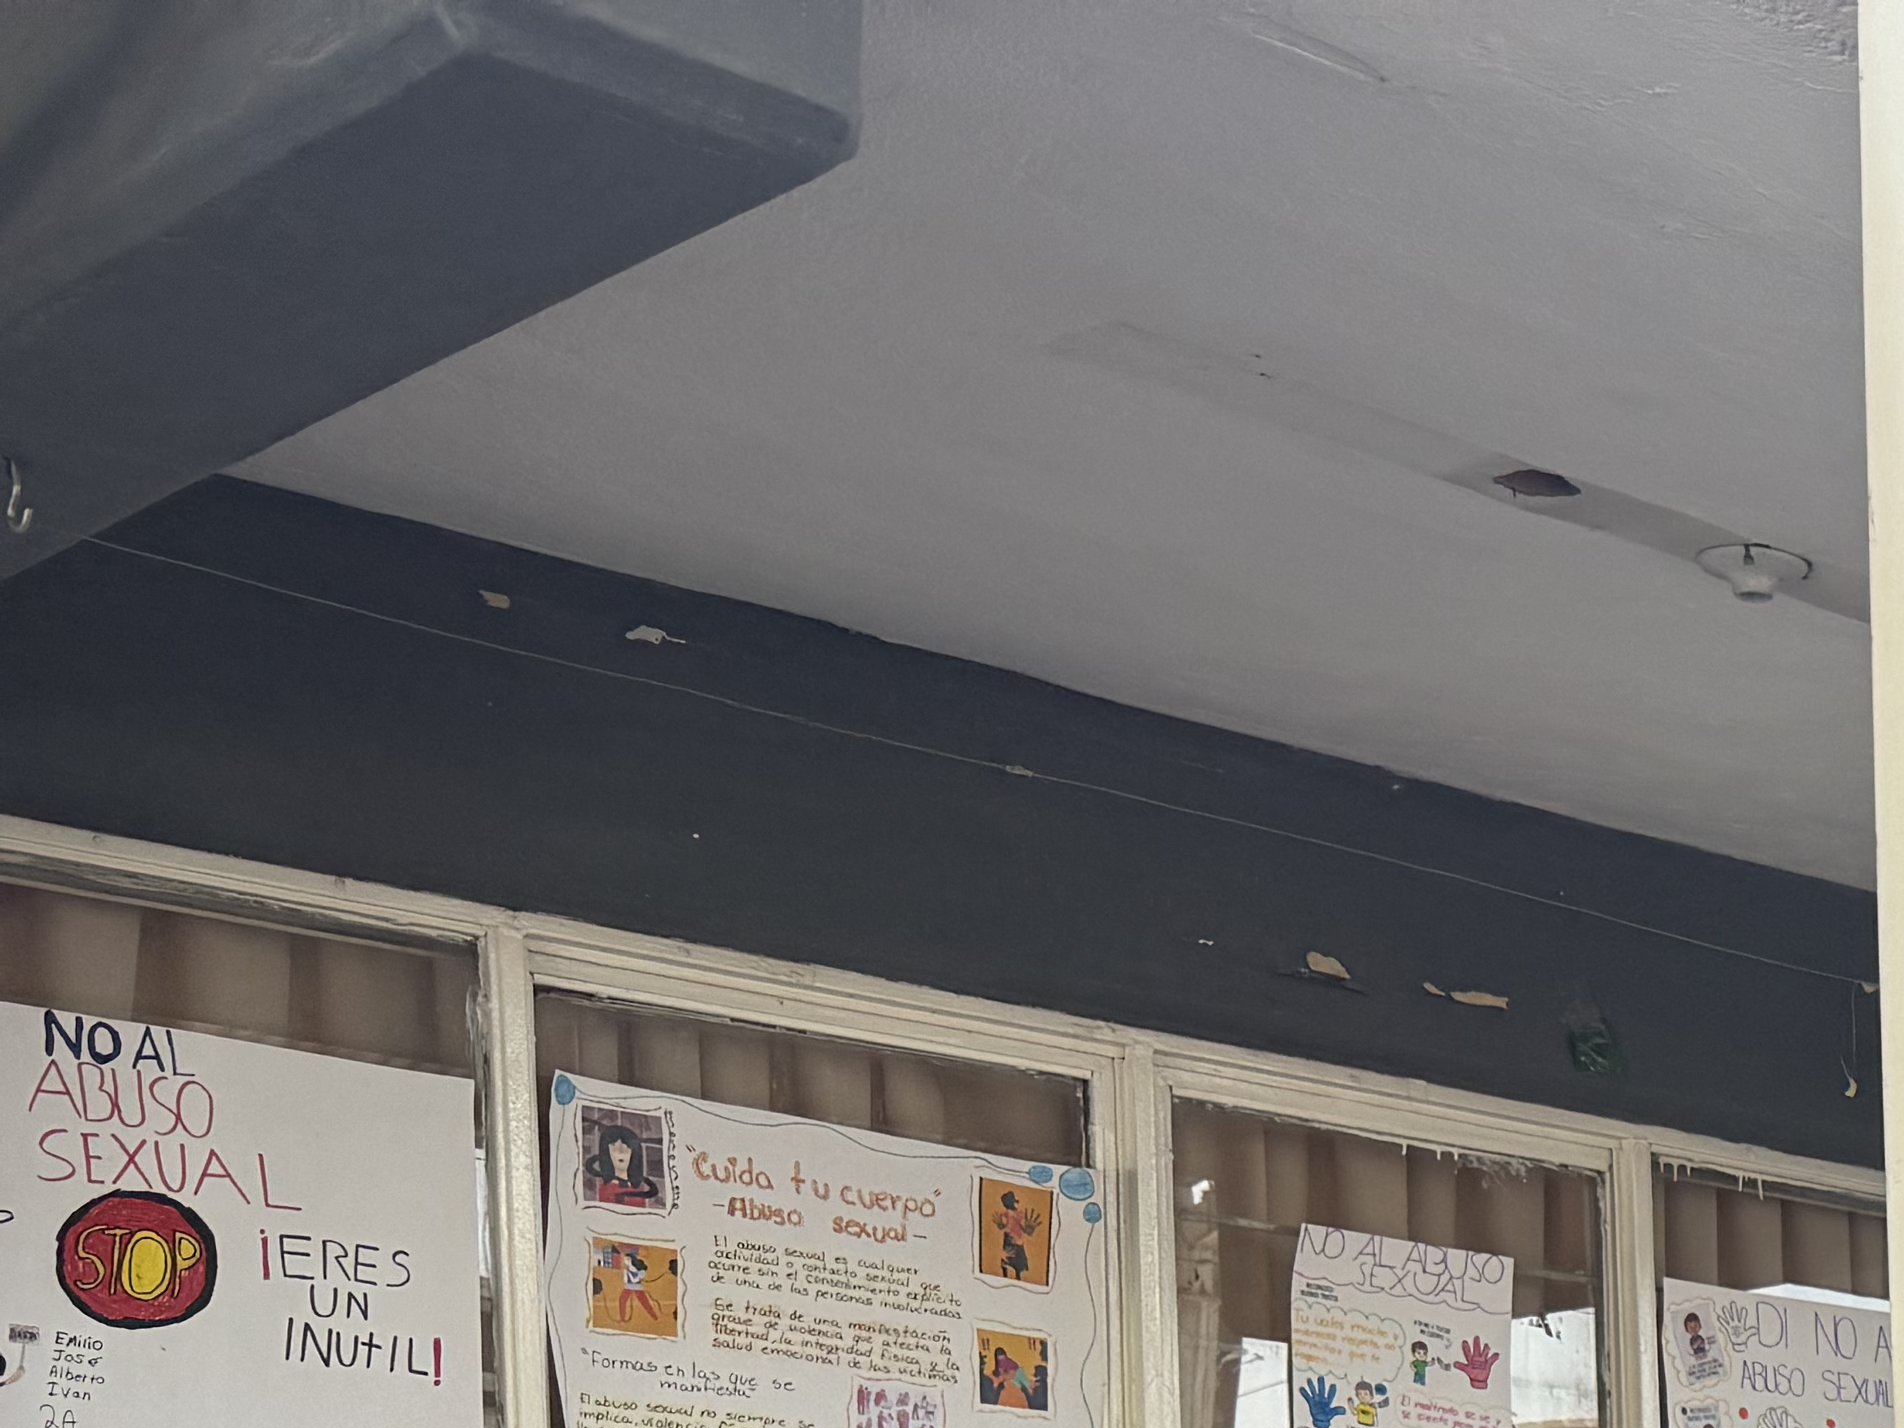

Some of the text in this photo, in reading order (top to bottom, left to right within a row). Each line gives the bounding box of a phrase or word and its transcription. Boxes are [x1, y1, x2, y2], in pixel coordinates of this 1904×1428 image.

[44, 1009, 195, 1077] NO AL
[29, 1059, 214, 1139] ABUSO
[37, 1128, 302, 1211] SEXUAL
[790, 1160, 830, 1201] tu
[76, 1226, 201, 1301] STOP
[1301, 1224, 1505, 1285] NO AL ABUSO
[1356, 1261, 1481, 1308] SEXUAL
[310, 1283, 370, 1321] UN
[1756, 1301, 1788, 1349] DI
[1814, 1311, 1857, 1360] NO
[1741, 1360, 1806, 1398] ABUSO
[1821, 1369, 1894, 1409] SEXUAL
